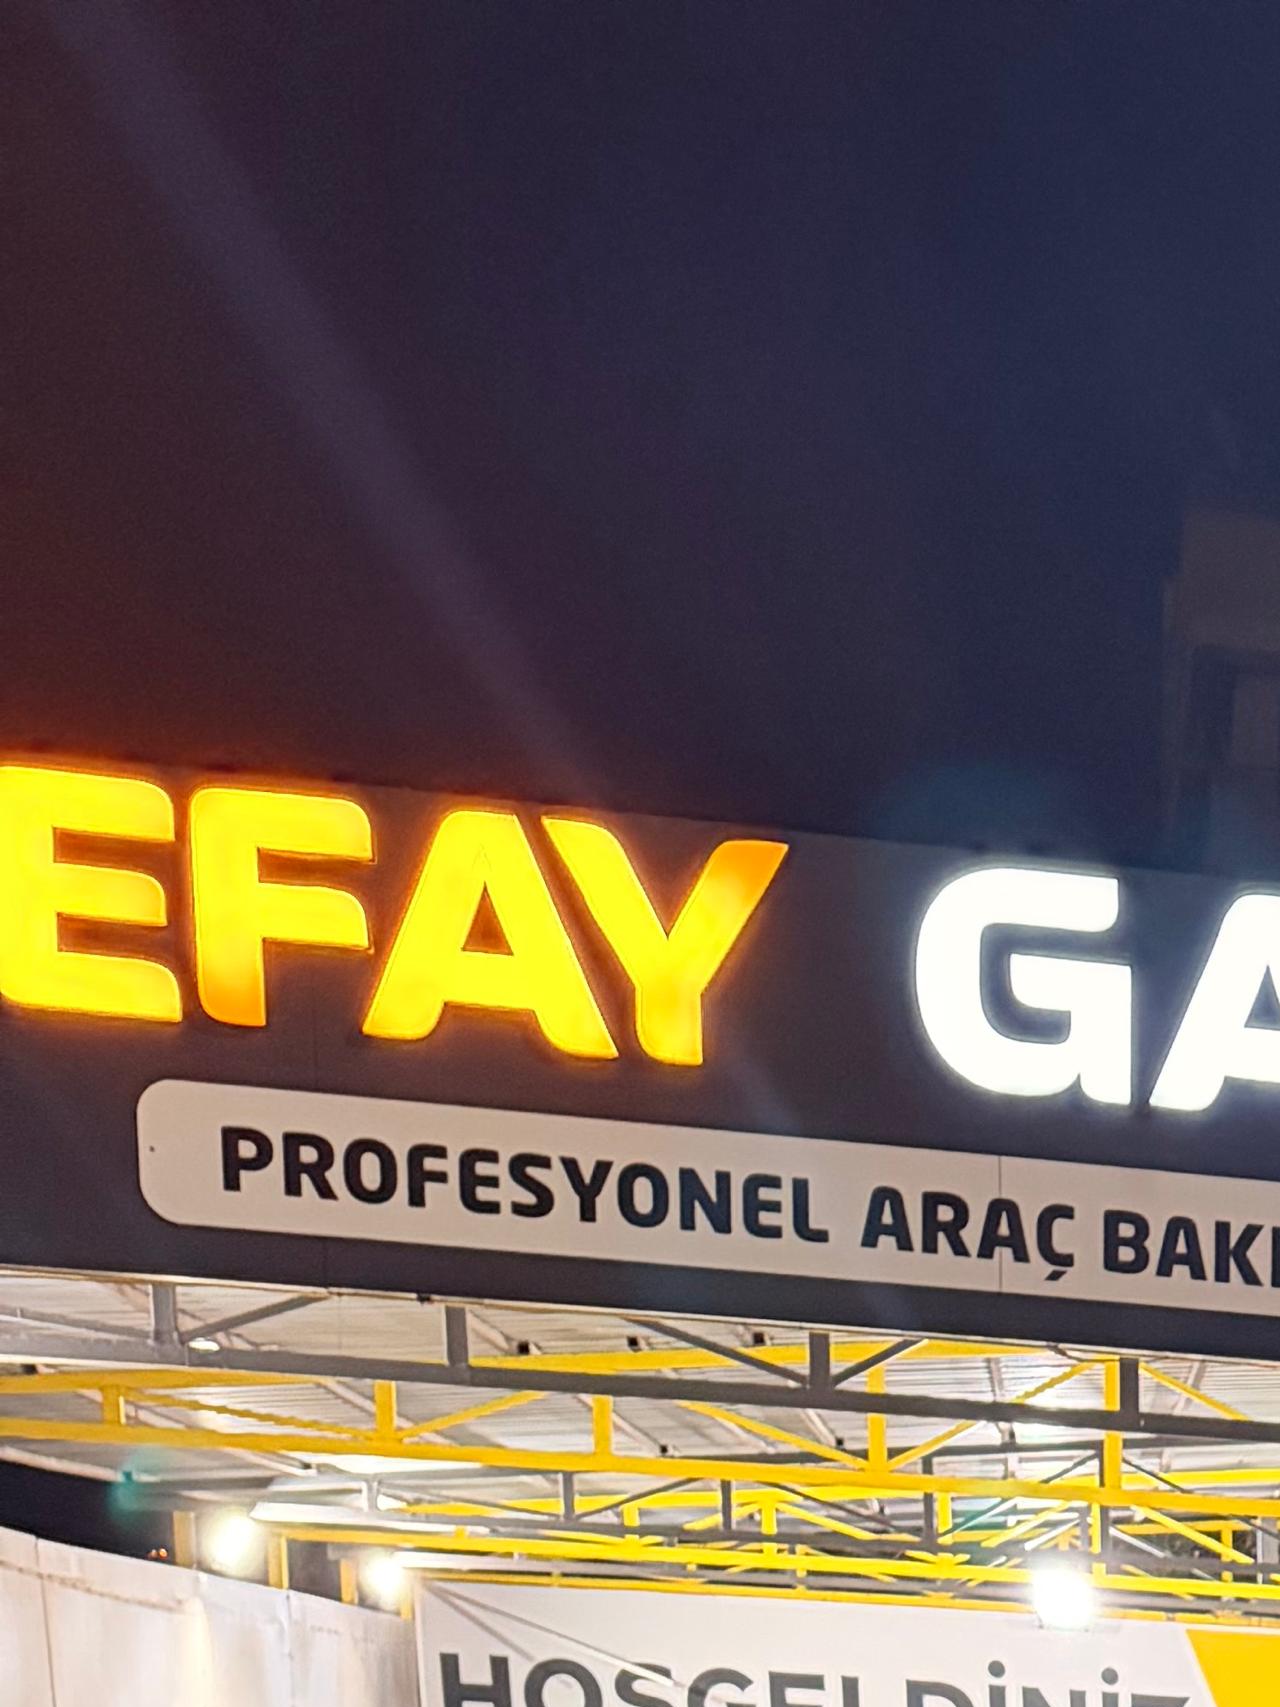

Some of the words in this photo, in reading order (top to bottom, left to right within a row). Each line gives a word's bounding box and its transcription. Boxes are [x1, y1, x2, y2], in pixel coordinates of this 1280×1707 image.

[0, 766, 787, 1066] EFAY
[222, 1126, 828, 1243] PROFESYONEL
[861, 1186, 1074, 1283] ARAÇ
